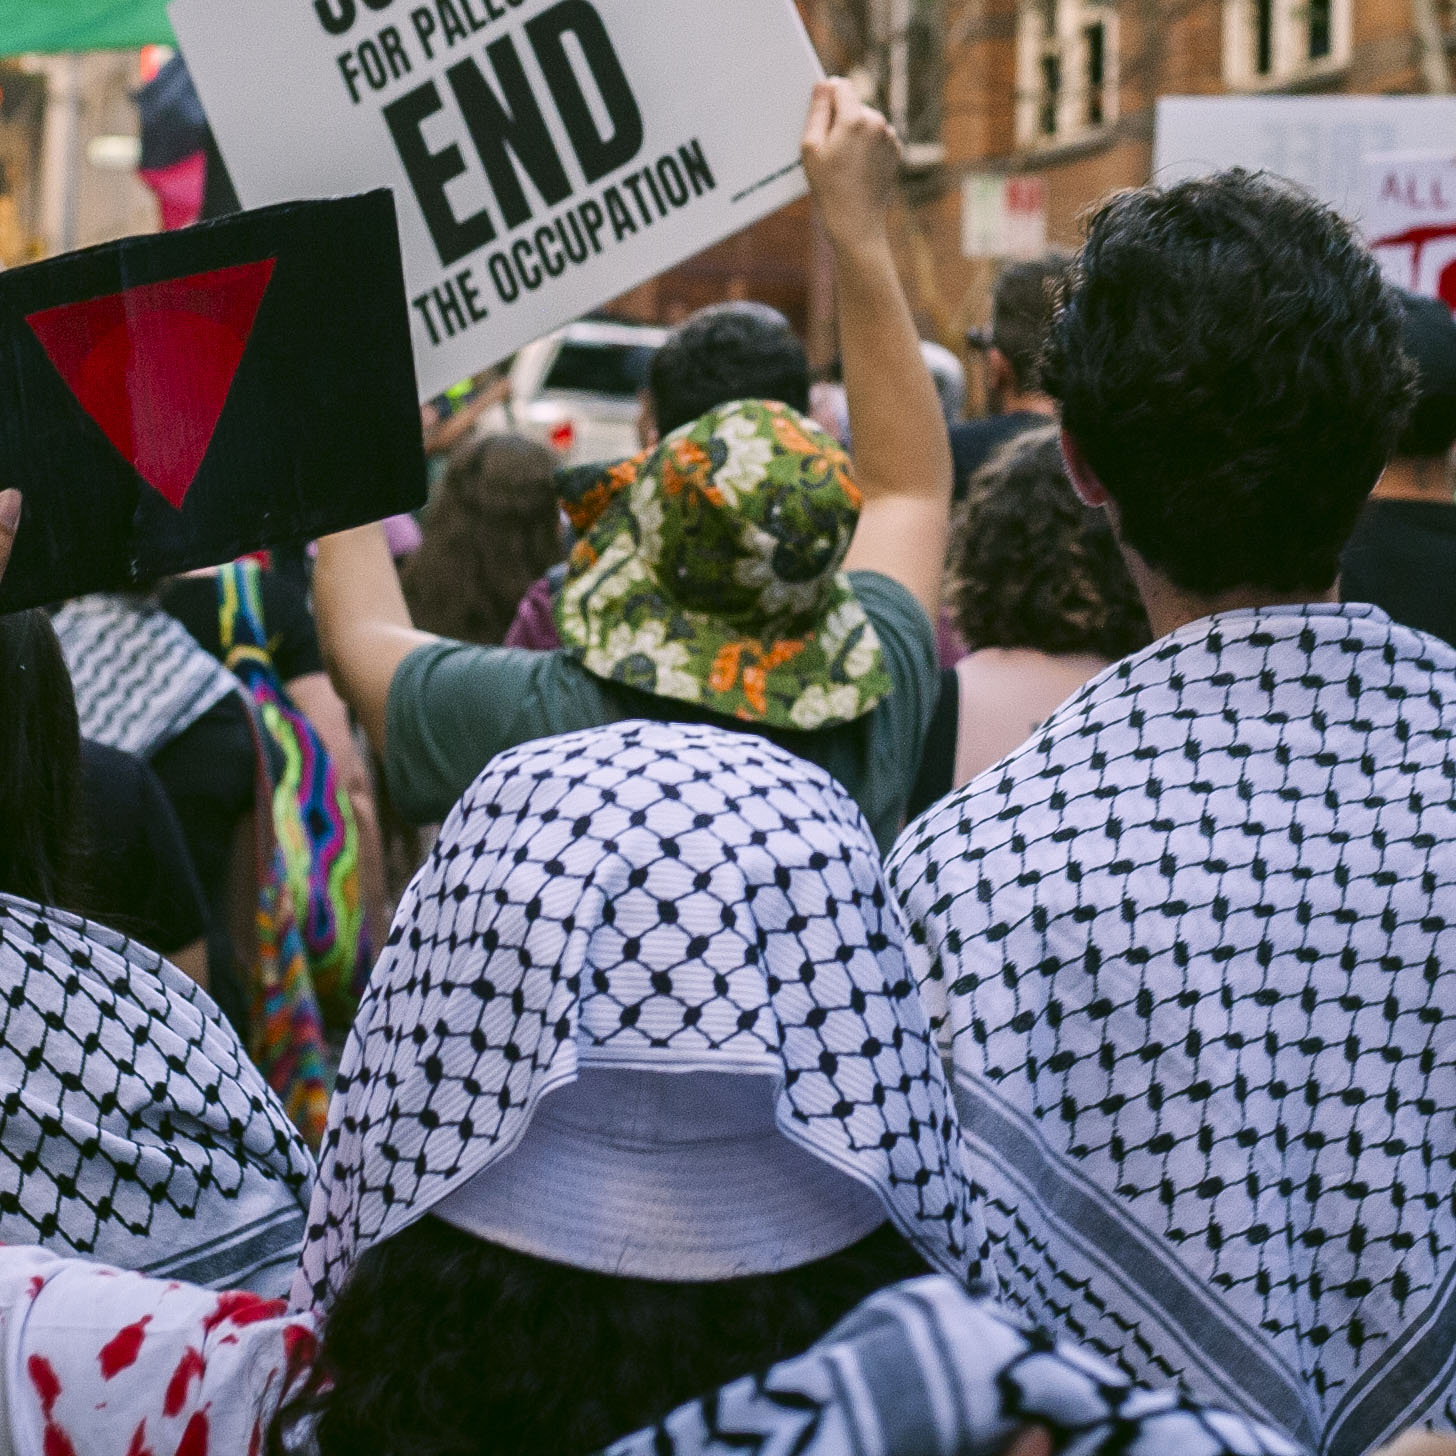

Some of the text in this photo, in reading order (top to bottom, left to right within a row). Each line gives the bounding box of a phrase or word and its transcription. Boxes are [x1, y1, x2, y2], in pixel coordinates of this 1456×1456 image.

[336, 24, 413, 105] FOR
[1377, 169, 1450, 211] ALL
[412, 136, 717, 346] THE OCCUPATION
